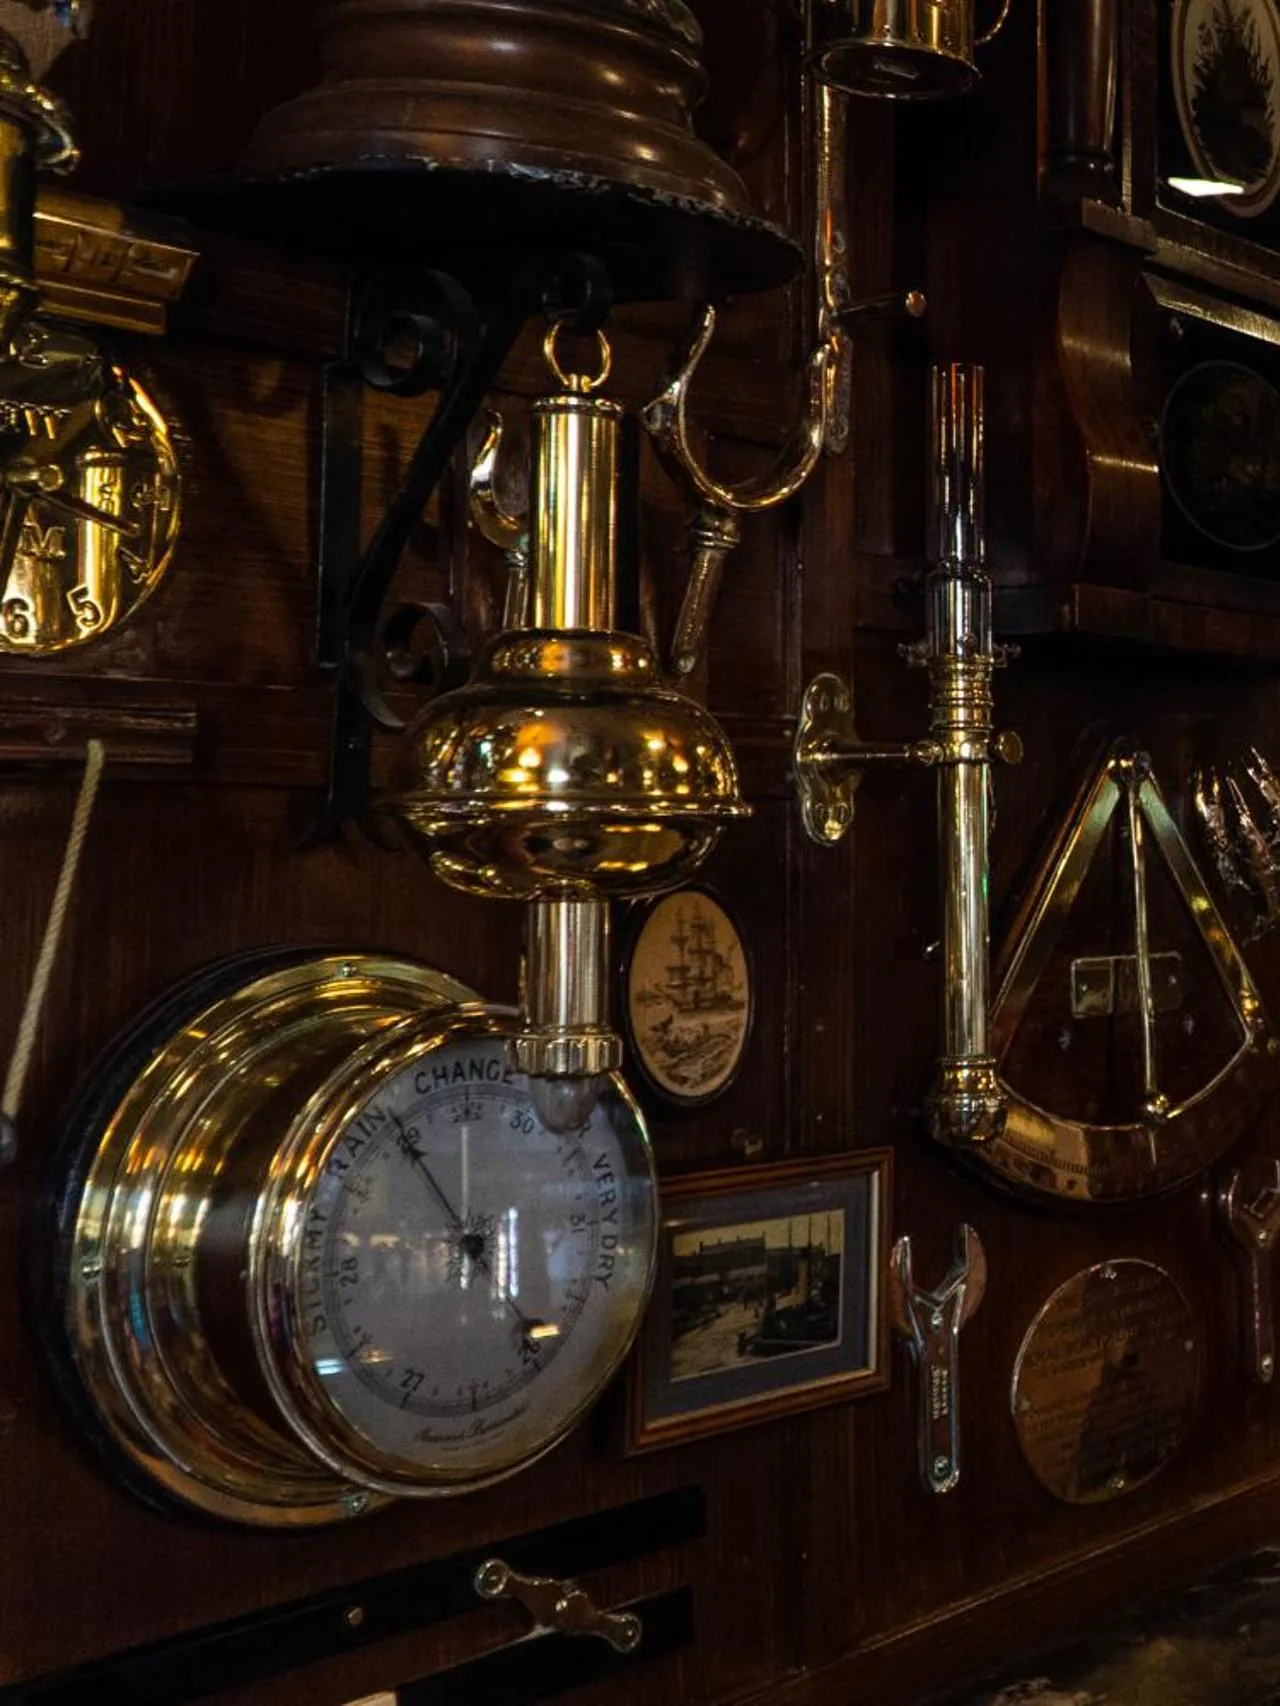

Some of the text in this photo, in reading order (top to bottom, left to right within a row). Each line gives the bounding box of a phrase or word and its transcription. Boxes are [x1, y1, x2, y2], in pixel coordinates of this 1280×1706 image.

[3, 598, 31, 640] 6
[66, 583, 104, 631] 5
[509, 1109, 535, 1135] 30
[593, 1152, 618, 1290] VERY DRY
[400, 1367, 426, 1393] 27
